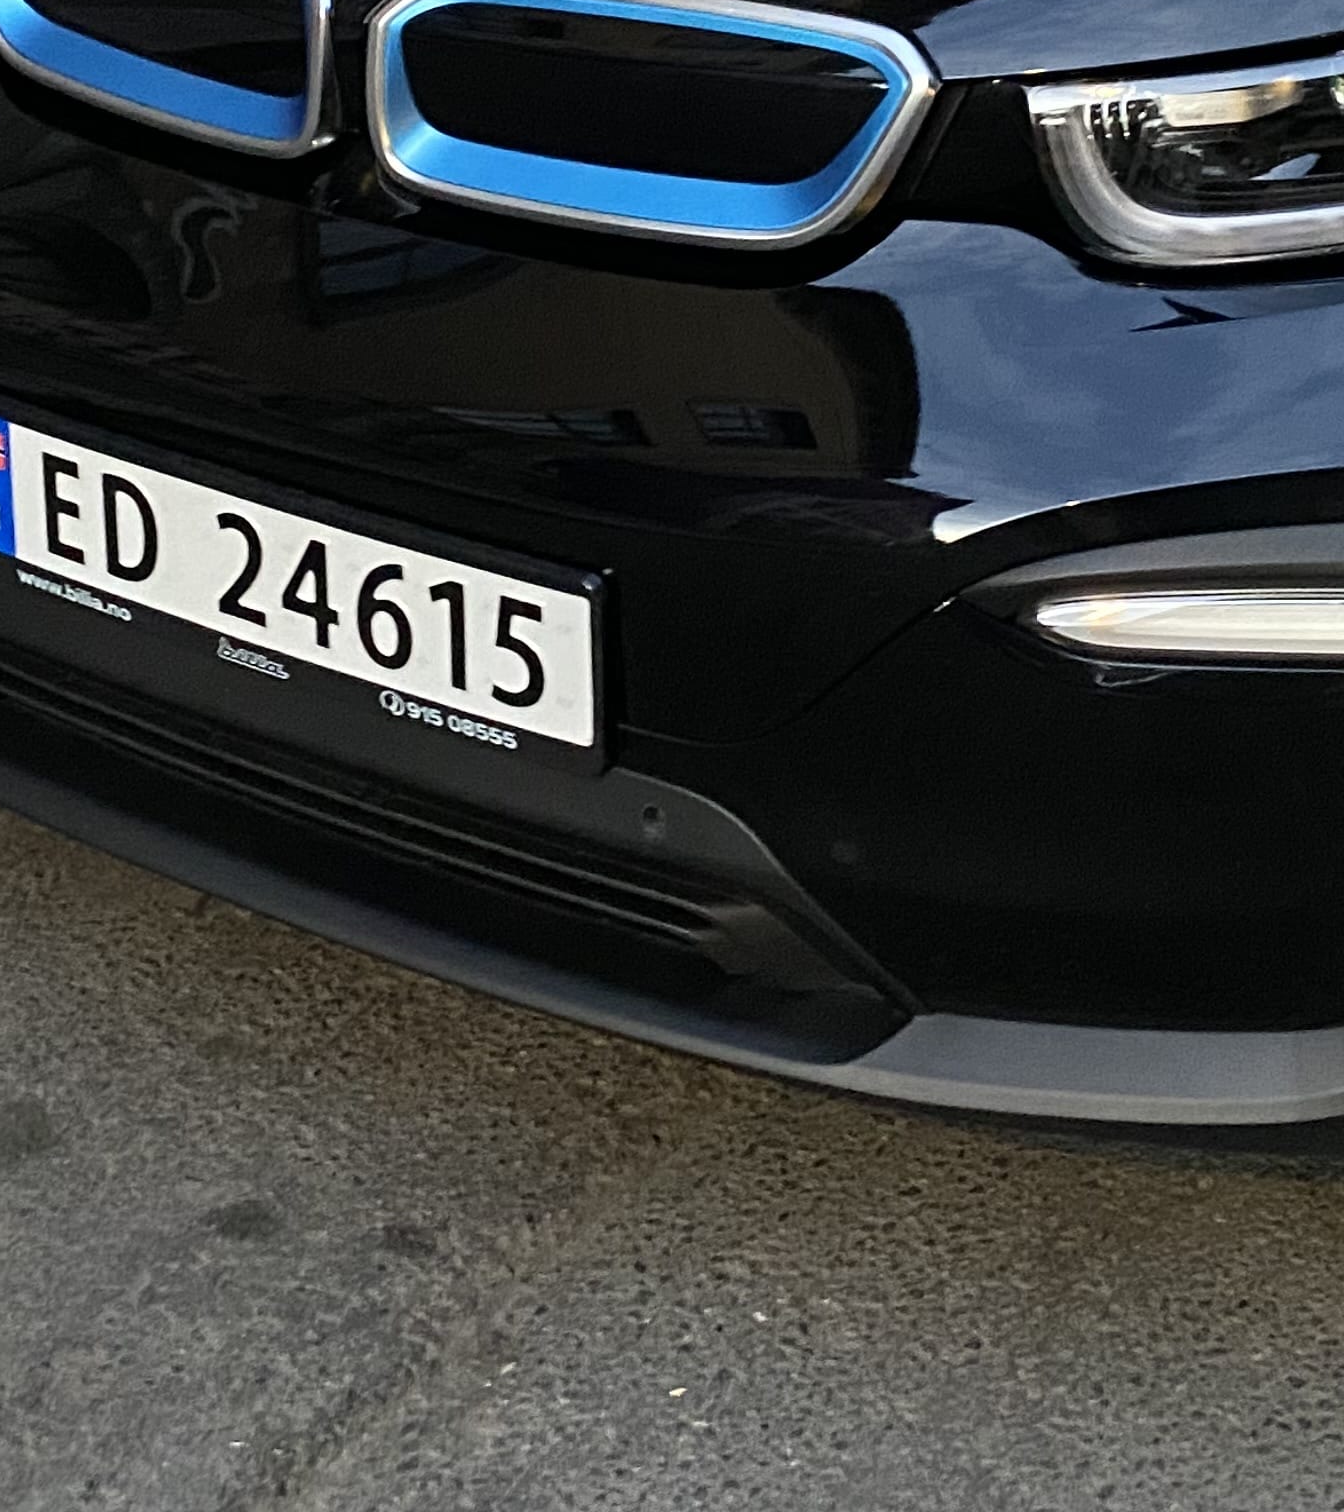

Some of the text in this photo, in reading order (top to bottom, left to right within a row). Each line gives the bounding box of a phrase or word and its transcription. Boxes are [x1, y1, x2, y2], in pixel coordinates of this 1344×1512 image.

[16, 568, 133, 623] www.bilia.no
[42, 451, 545, 708] ED 24615
[406, 700, 518, 750] 915 08555
